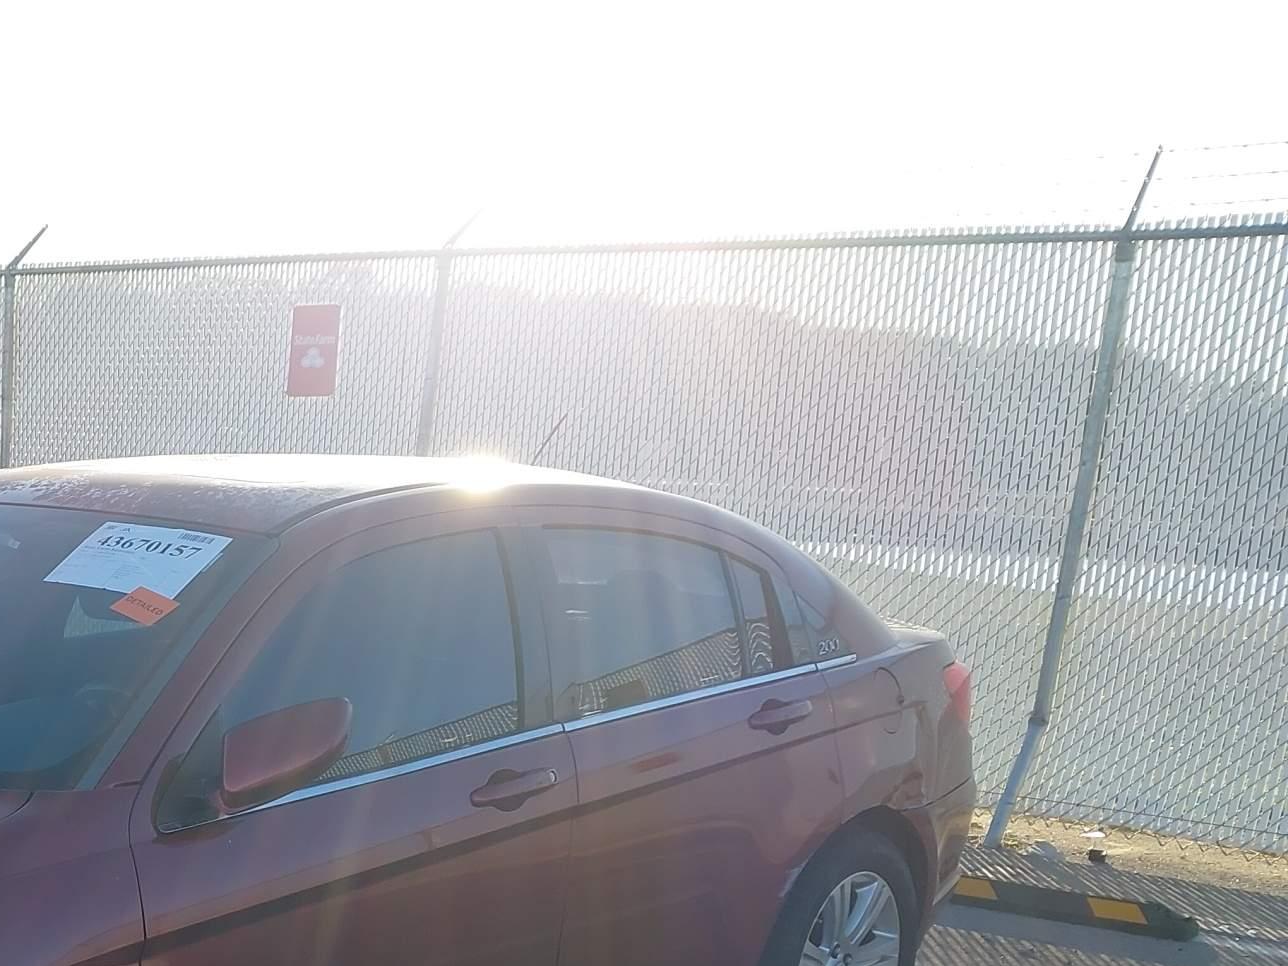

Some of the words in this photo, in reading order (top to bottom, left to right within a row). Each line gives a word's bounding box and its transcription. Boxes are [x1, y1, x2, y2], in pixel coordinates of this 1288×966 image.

[97, 535, 203, 560] 43670157
[125, 595, 164, 616] DETAILED
[818, 638, 840, 655] 200
